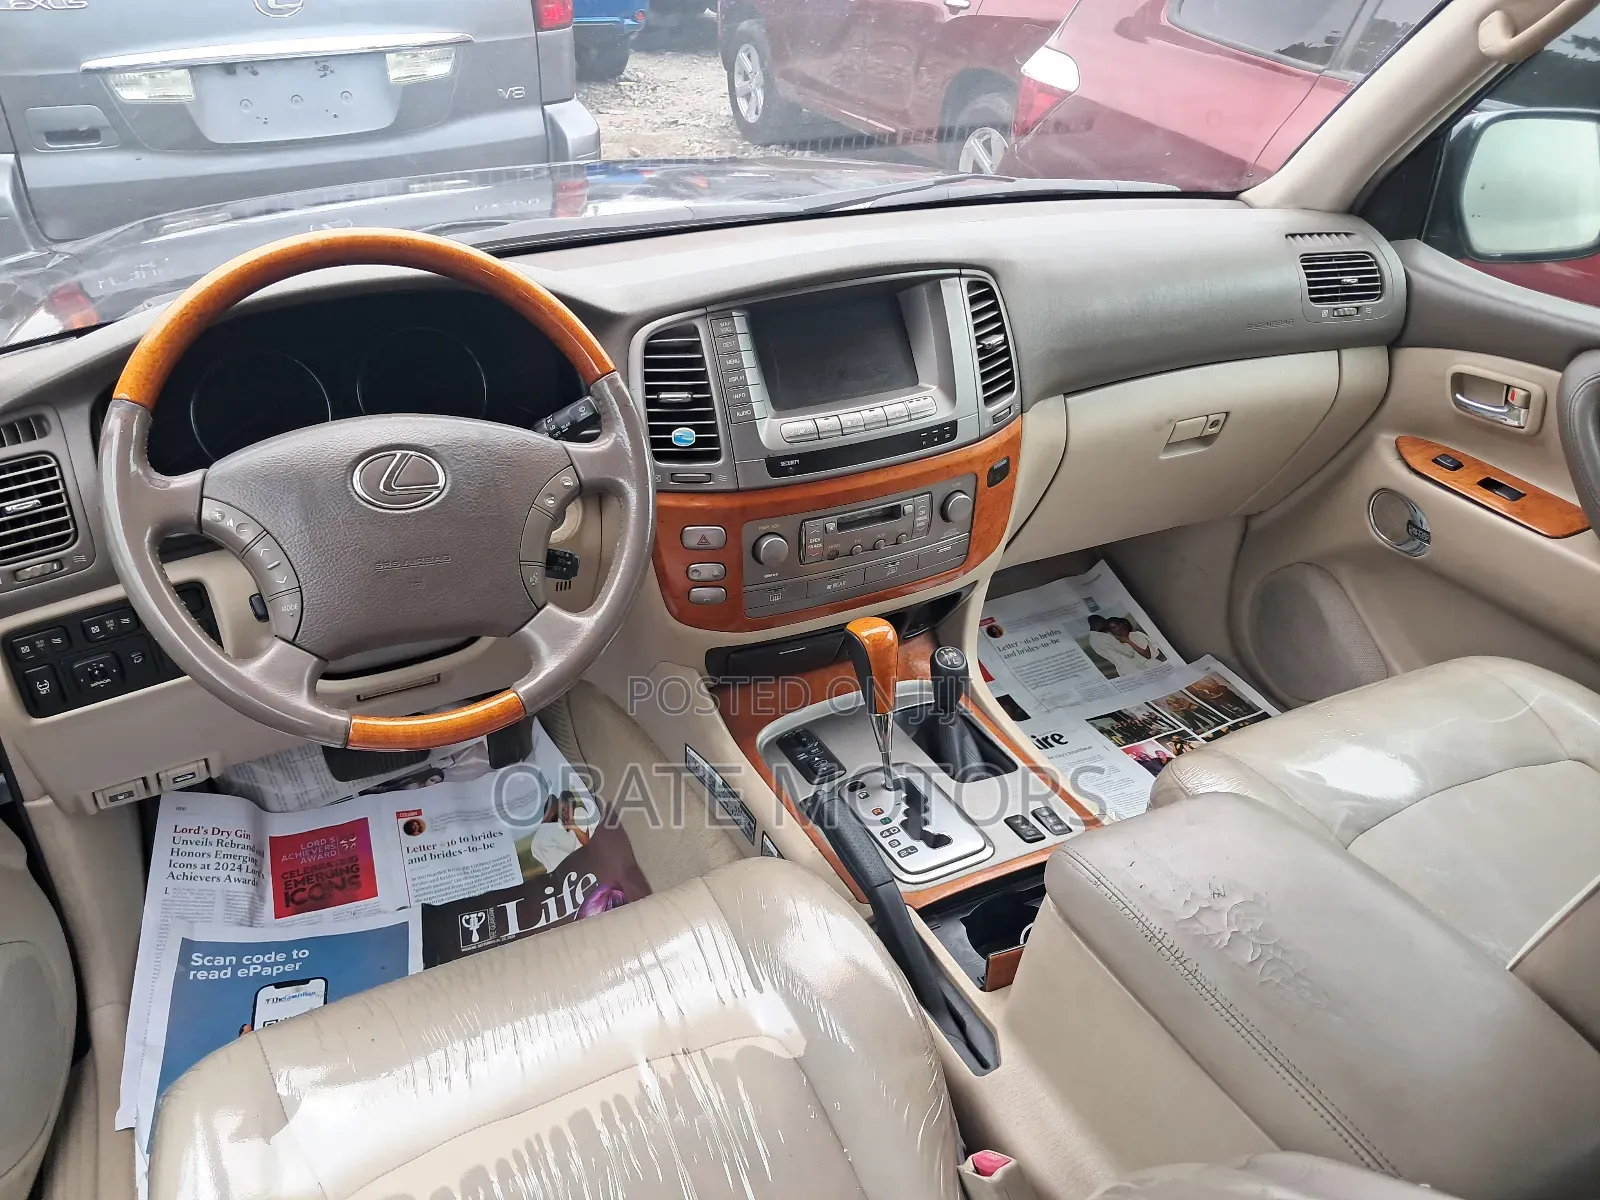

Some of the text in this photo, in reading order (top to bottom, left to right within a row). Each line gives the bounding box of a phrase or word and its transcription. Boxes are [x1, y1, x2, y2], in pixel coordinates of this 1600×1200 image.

[497, 86, 526, 99] V8
[736, 409, 752, 417] AUDIO
[780, 459, 800, 467] SECURITY
[996, 641, 1018, 652] Letter
[1039, 629, 1062, 640] brides
[1003, 638, 1060, 660] and brides-to-be
[173, 824, 251, 840] Lord's Dry Gin
[172, 836, 213, 847] Unveils
[216, 838, 256, 852] Rebrand
[300, 837, 336, 850] LORD'S
[406, 843, 438, 854] Letter
[458, 836, 469, 844] to
[470, 830, 504, 842] brides
[170, 847, 258, 866] Honors Emerging
[281, 844, 336, 862] ACHIEVERS
[300, 850, 337, 864] AWARD
[407, 841, 495, 865] and brides-to-be
[166, 871, 221, 882] Achievers
[168, 859, 198, 870] Icons
[214, 861, 243, 873] 2024
[245, 865, 265, 879] Lord's
[281, 856, 359, 880] CELEBRATING
[284, 864, 360, 890] EMERGING
[284, 875, 362, 908] ICONS
[497, 871, 597, 938] Life
[190, 948, 310, 966] Scan code to
[189, 961, 302, 980] read ePaper
